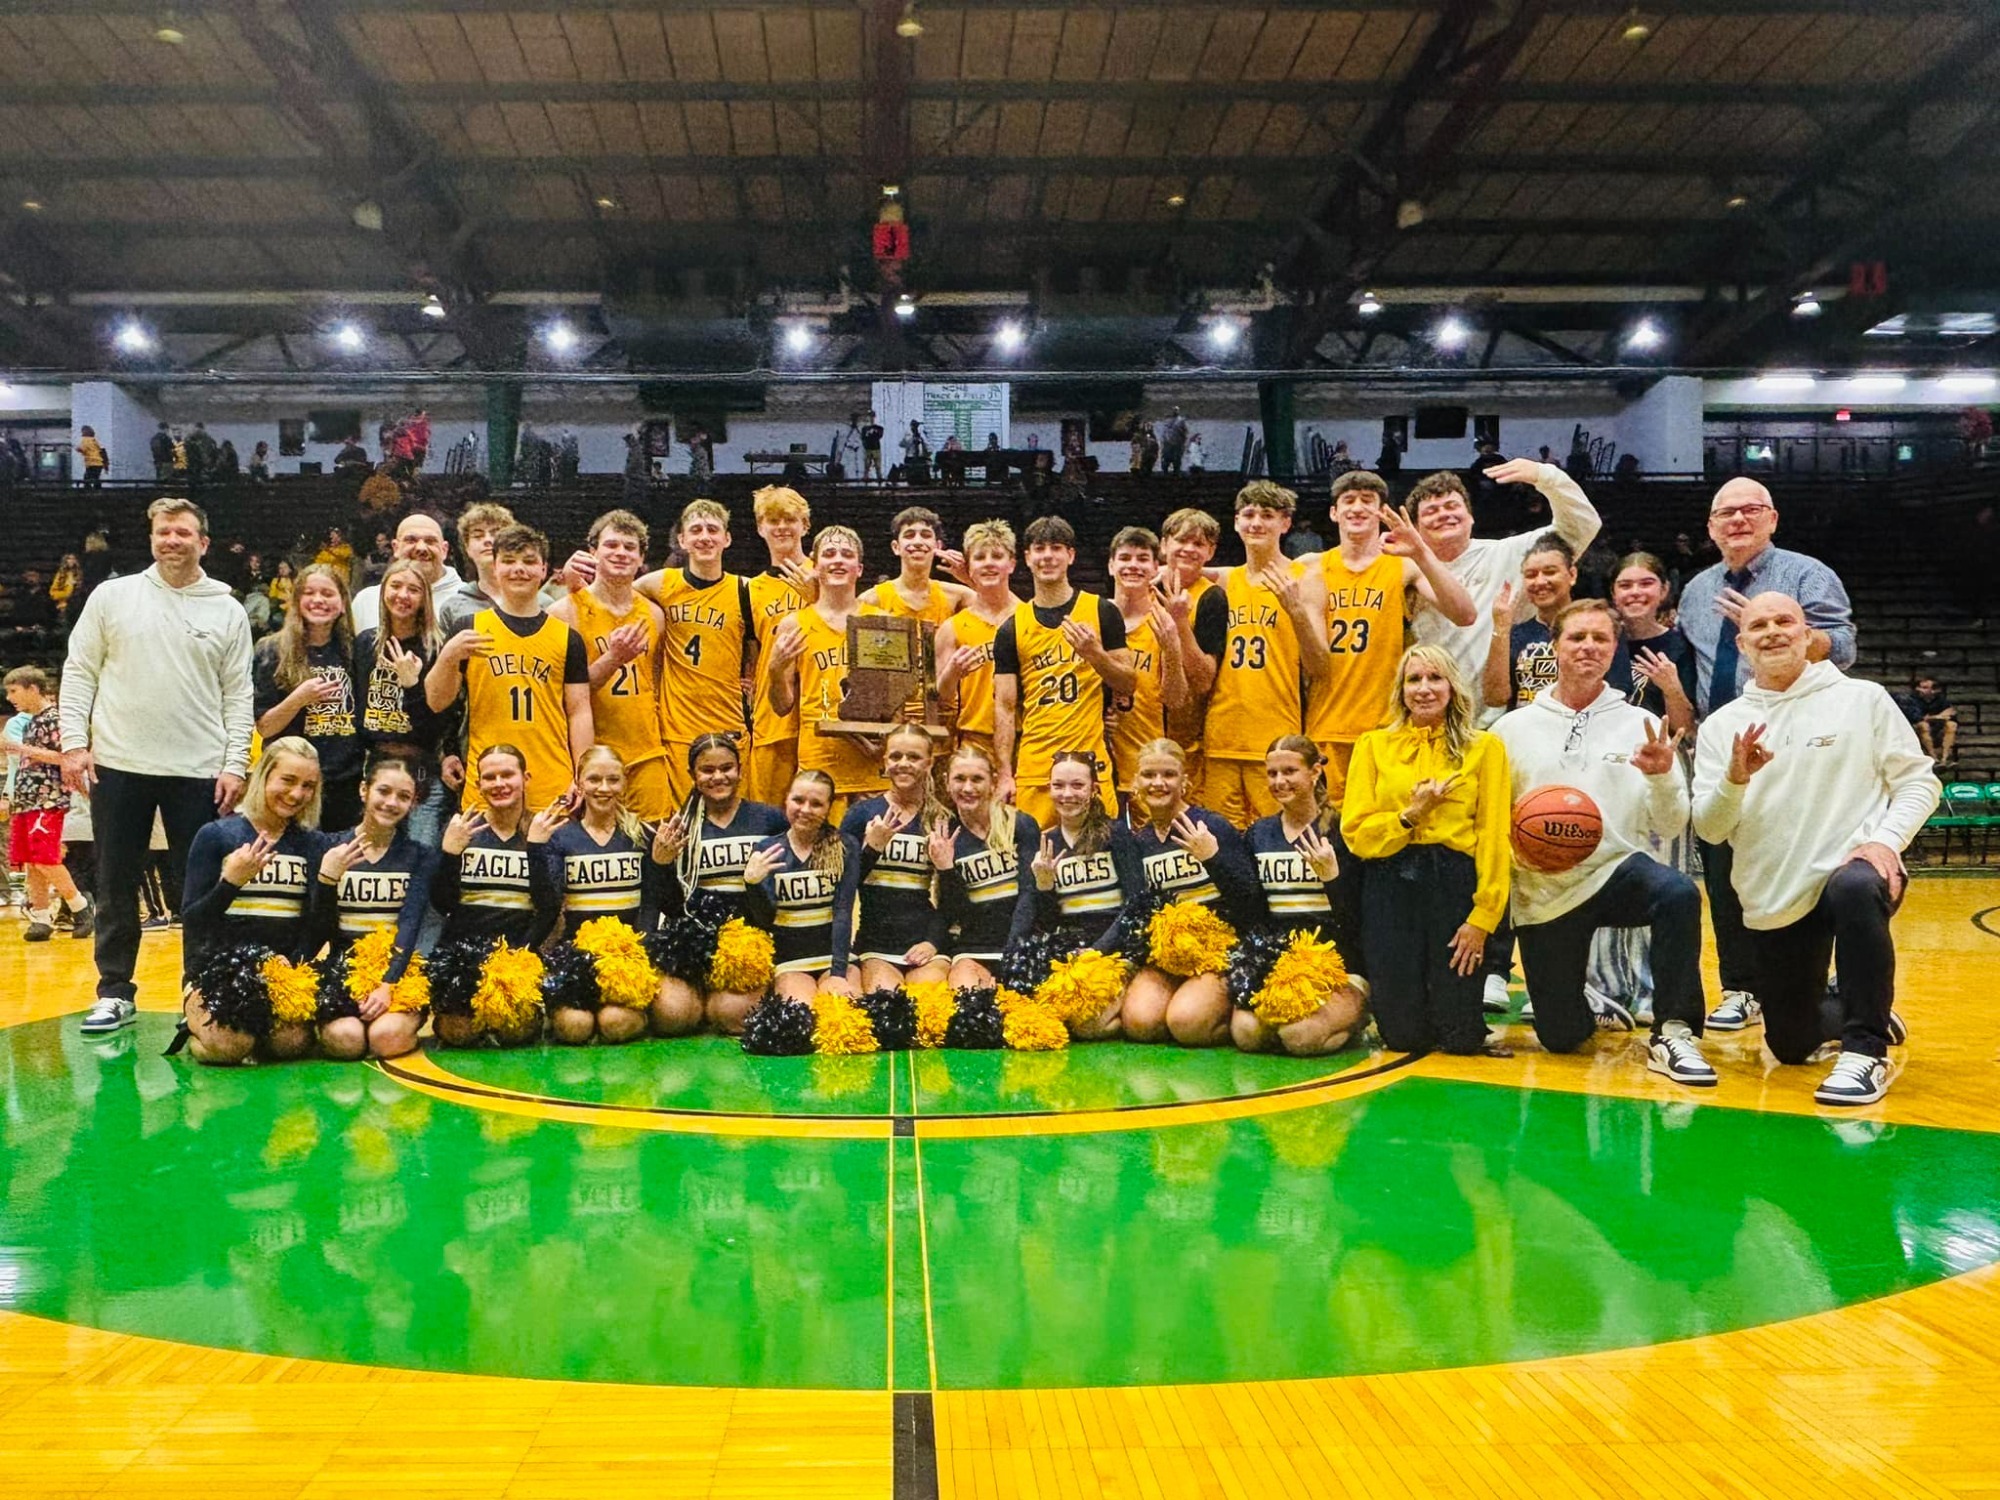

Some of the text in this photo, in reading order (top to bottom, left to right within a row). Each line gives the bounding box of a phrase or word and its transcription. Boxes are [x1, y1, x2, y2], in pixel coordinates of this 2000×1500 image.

[1328, 587, 1385, 612] DELTA
[667, 603, 726, 631] DELTA
[1228, 604, 1279, 629] DELTA
[684, 634, 701, 666] 4
[1330, 619, 1369, 654] 23
[813, 646, 850, 671] DEL
[1230, 635, 1267, 670] 33
[488, 653, 552, 684] DELTA
[611, 663, 640, 696] 21
[1038, 671, 1079, 706] 20
[509, 685, 533, 722] 11
[1544, 821, 1602, 838] Wilson
[460, 852, 530, 879] EAGLE
[699, 841, 757, 869] AGLE
[566, 857, 641, 886] EAGLES
